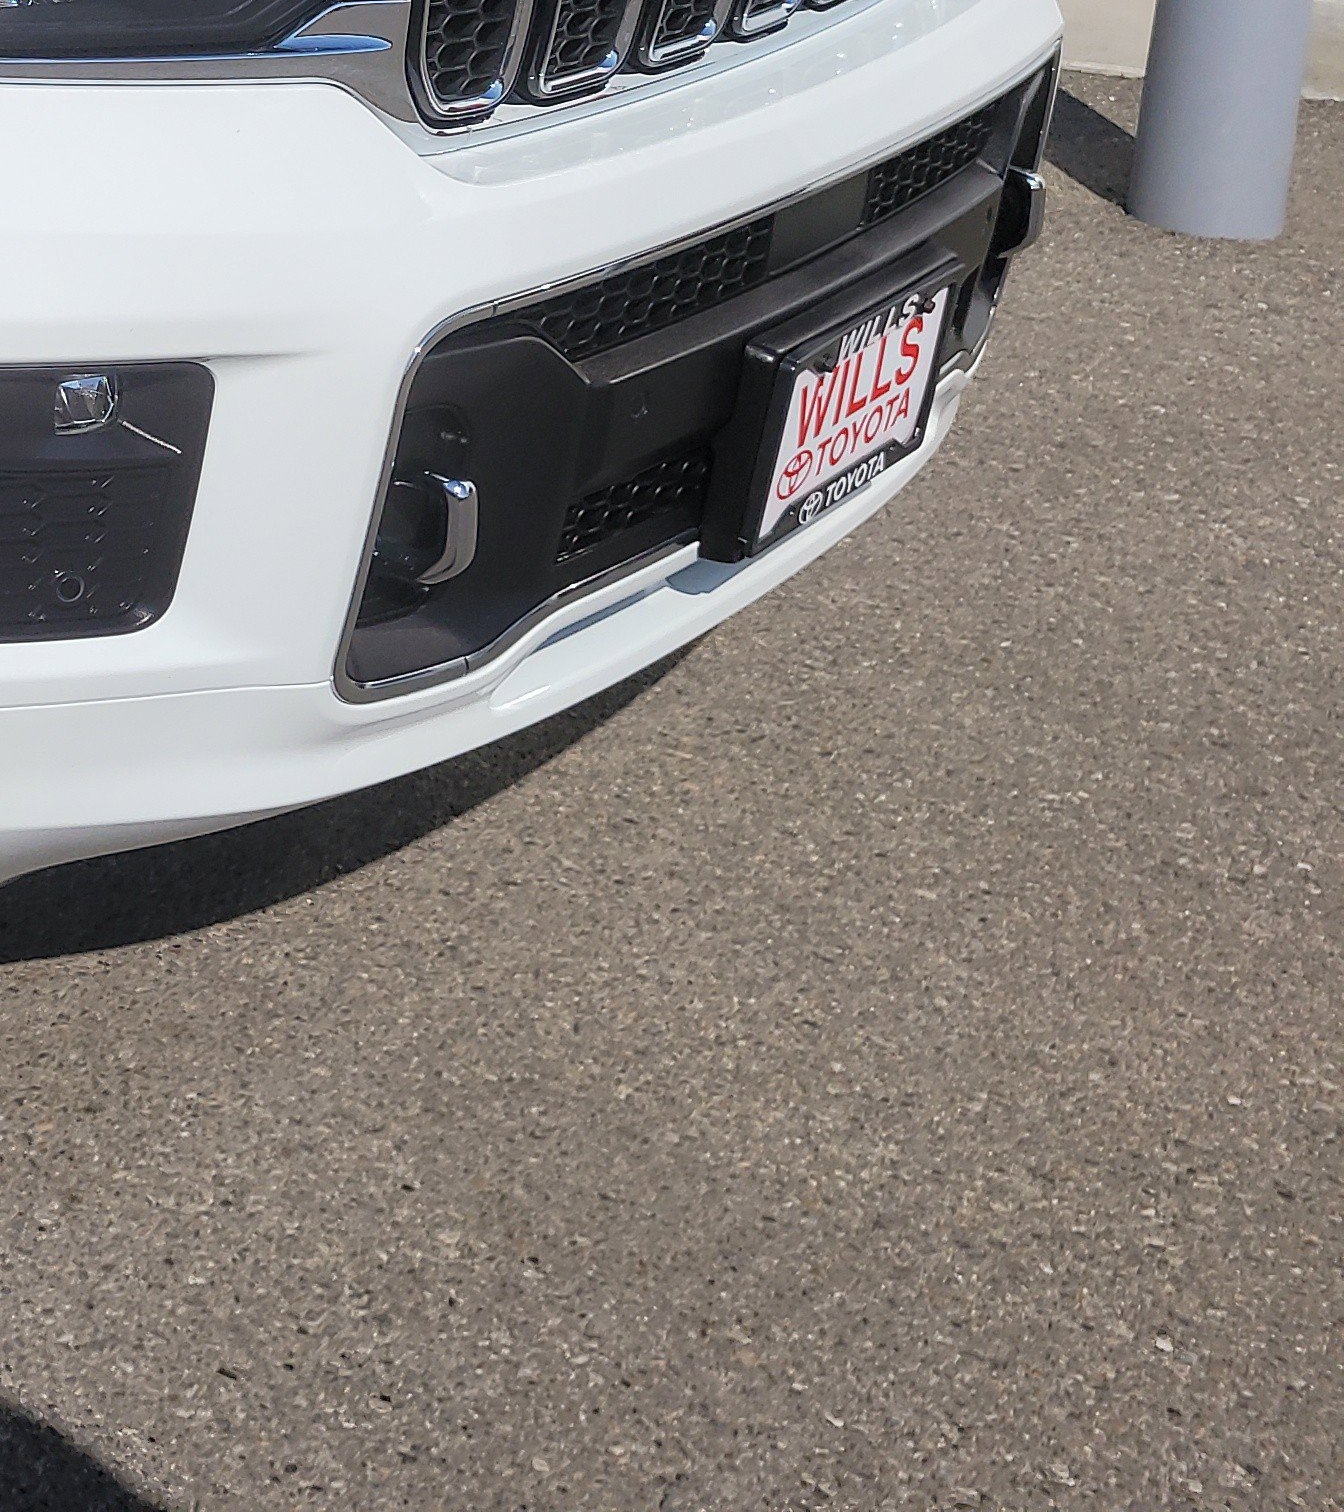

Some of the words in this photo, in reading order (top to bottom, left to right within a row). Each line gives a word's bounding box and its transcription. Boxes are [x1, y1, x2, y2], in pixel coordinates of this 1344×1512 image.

[838, 293, 922, 360] WILLS
[796, 315, 924, 448] WILLS
[815, 387, 910, 476] TOYOTA
[824, 451, 885, 506] TOYOTA
